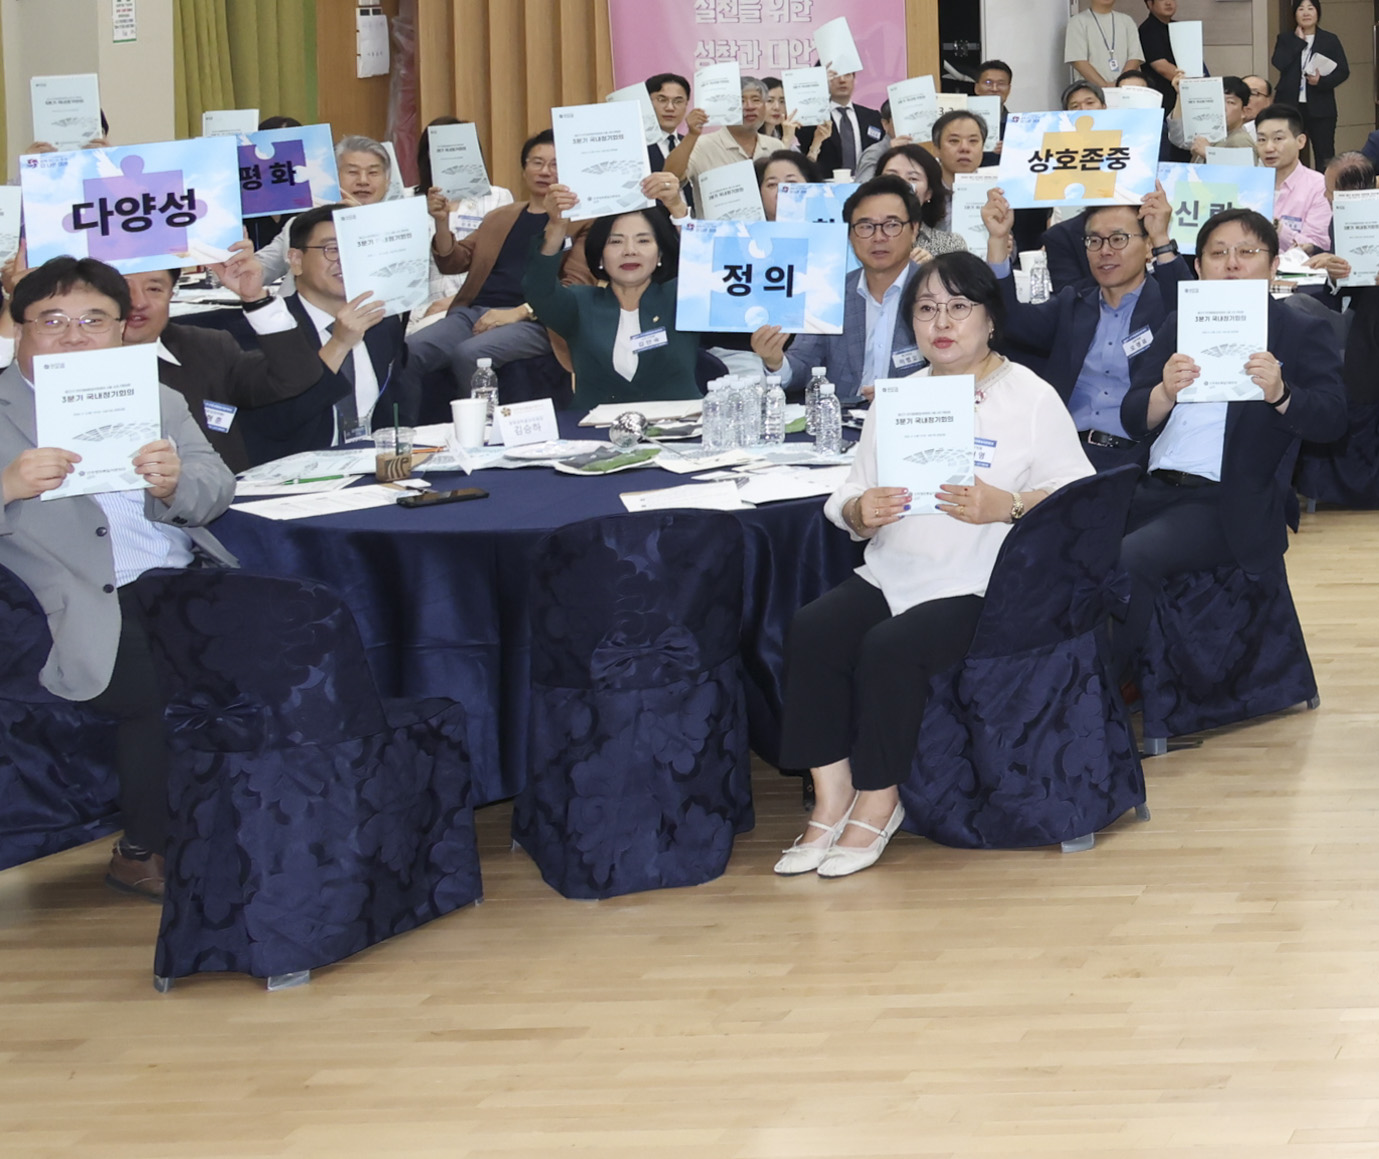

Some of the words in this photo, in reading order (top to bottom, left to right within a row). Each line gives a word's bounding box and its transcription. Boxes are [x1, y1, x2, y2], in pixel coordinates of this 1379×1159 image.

[1027, 147, 1131, 173] 상호존중
[239, 161, 297, 191] 평화
[71, 188, 197, 236] 다양성
[722, 263, 795, 298] 정의
[62, 394, 84, 404] 3분기
[86, 388, 135, 401] 국내정기회의
